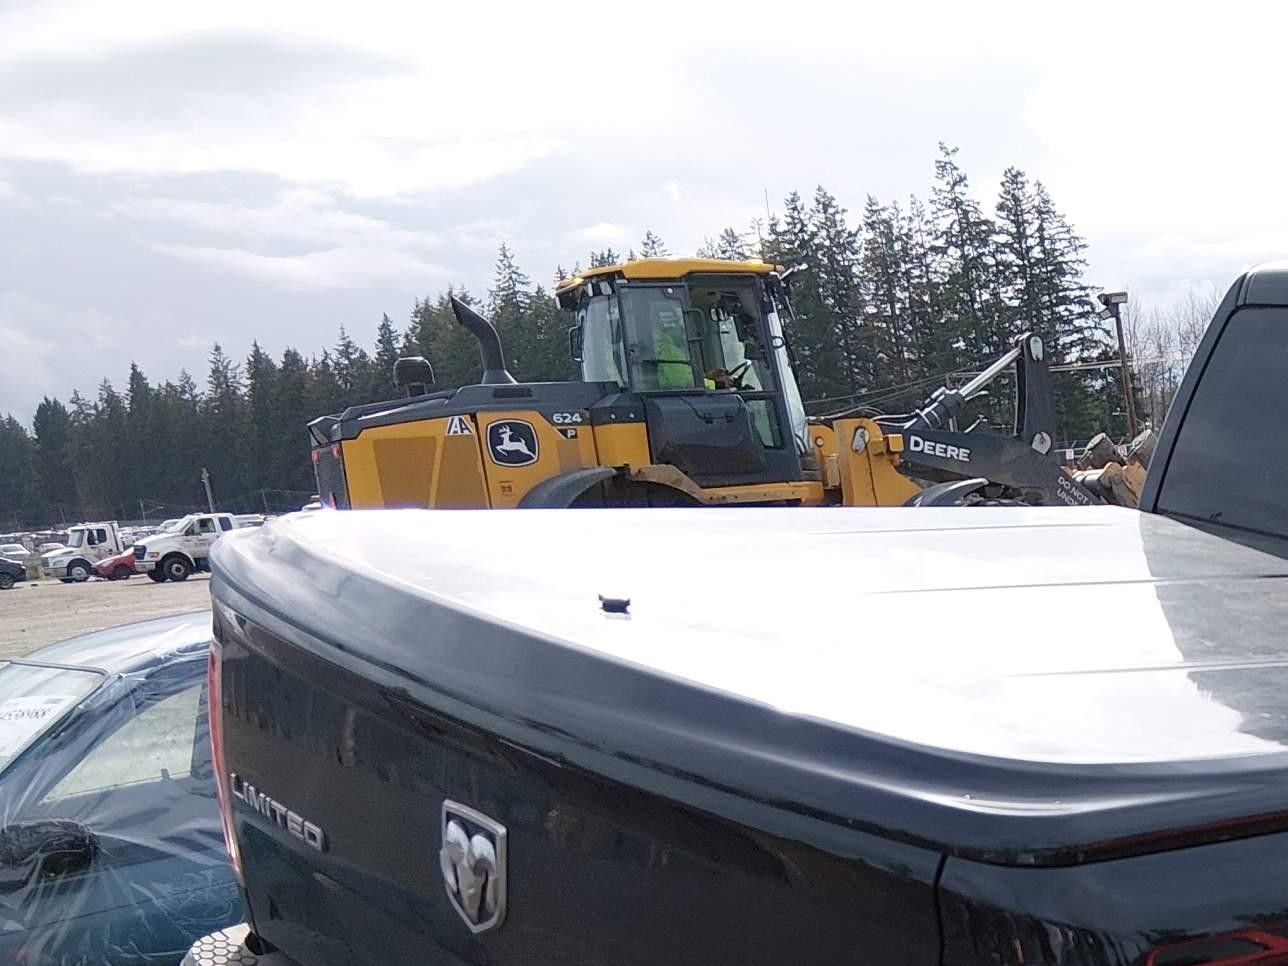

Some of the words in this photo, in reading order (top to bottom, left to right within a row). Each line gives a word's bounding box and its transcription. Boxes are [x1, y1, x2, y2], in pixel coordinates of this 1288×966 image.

[552, 413, 583, 424] 624
[567, 429, 576, 438] P
[910, 435, 970, 462] DEERE
[1058, 476, 1070, 489] DO
[1070, 487, 1088, 504] NOT
[230, 772, 323, 852] LIMITED
